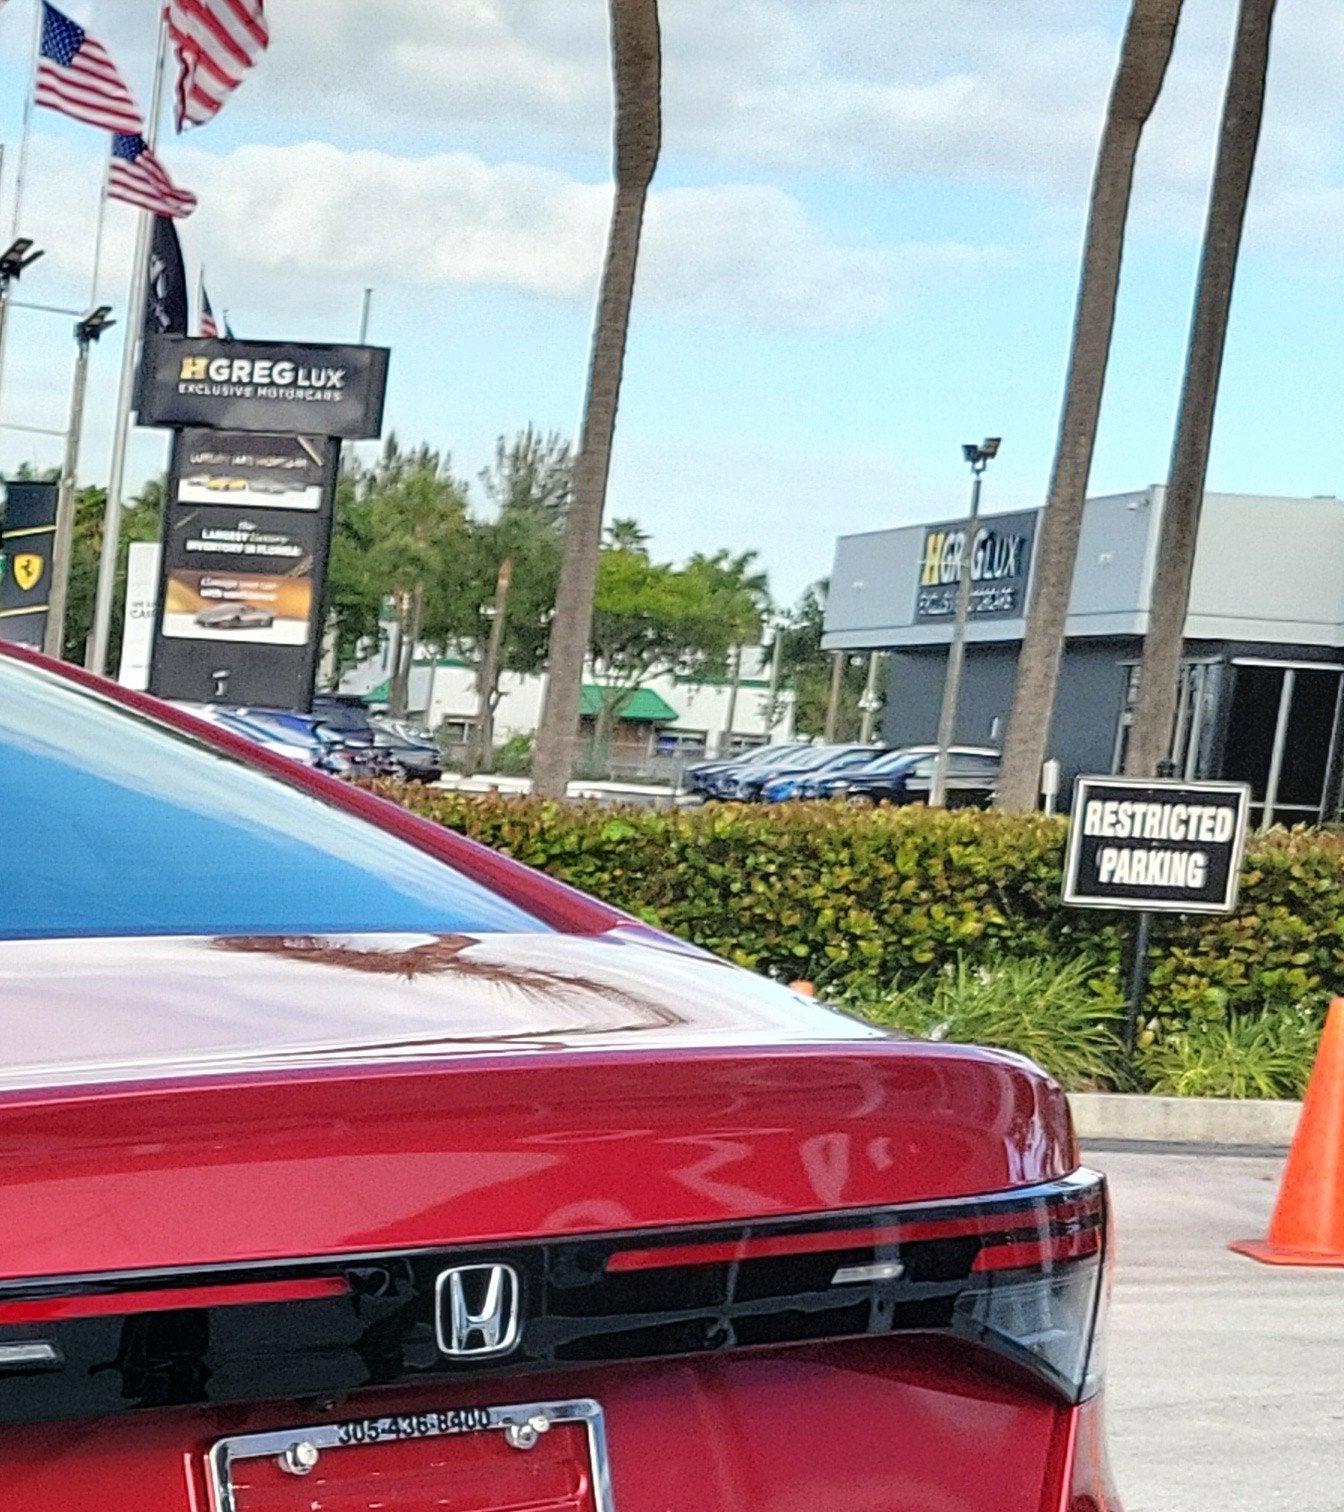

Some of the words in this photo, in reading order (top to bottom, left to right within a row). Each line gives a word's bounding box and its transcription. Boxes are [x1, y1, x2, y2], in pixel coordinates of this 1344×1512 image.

[178, 382, 253, 397] EXCLUSIVE
[1084, 800, 1234, 842] RESTRICTED
[1096, 846, 1208, 888] PARKING
[337, 1408, 491, 1445] 305-436-8400
